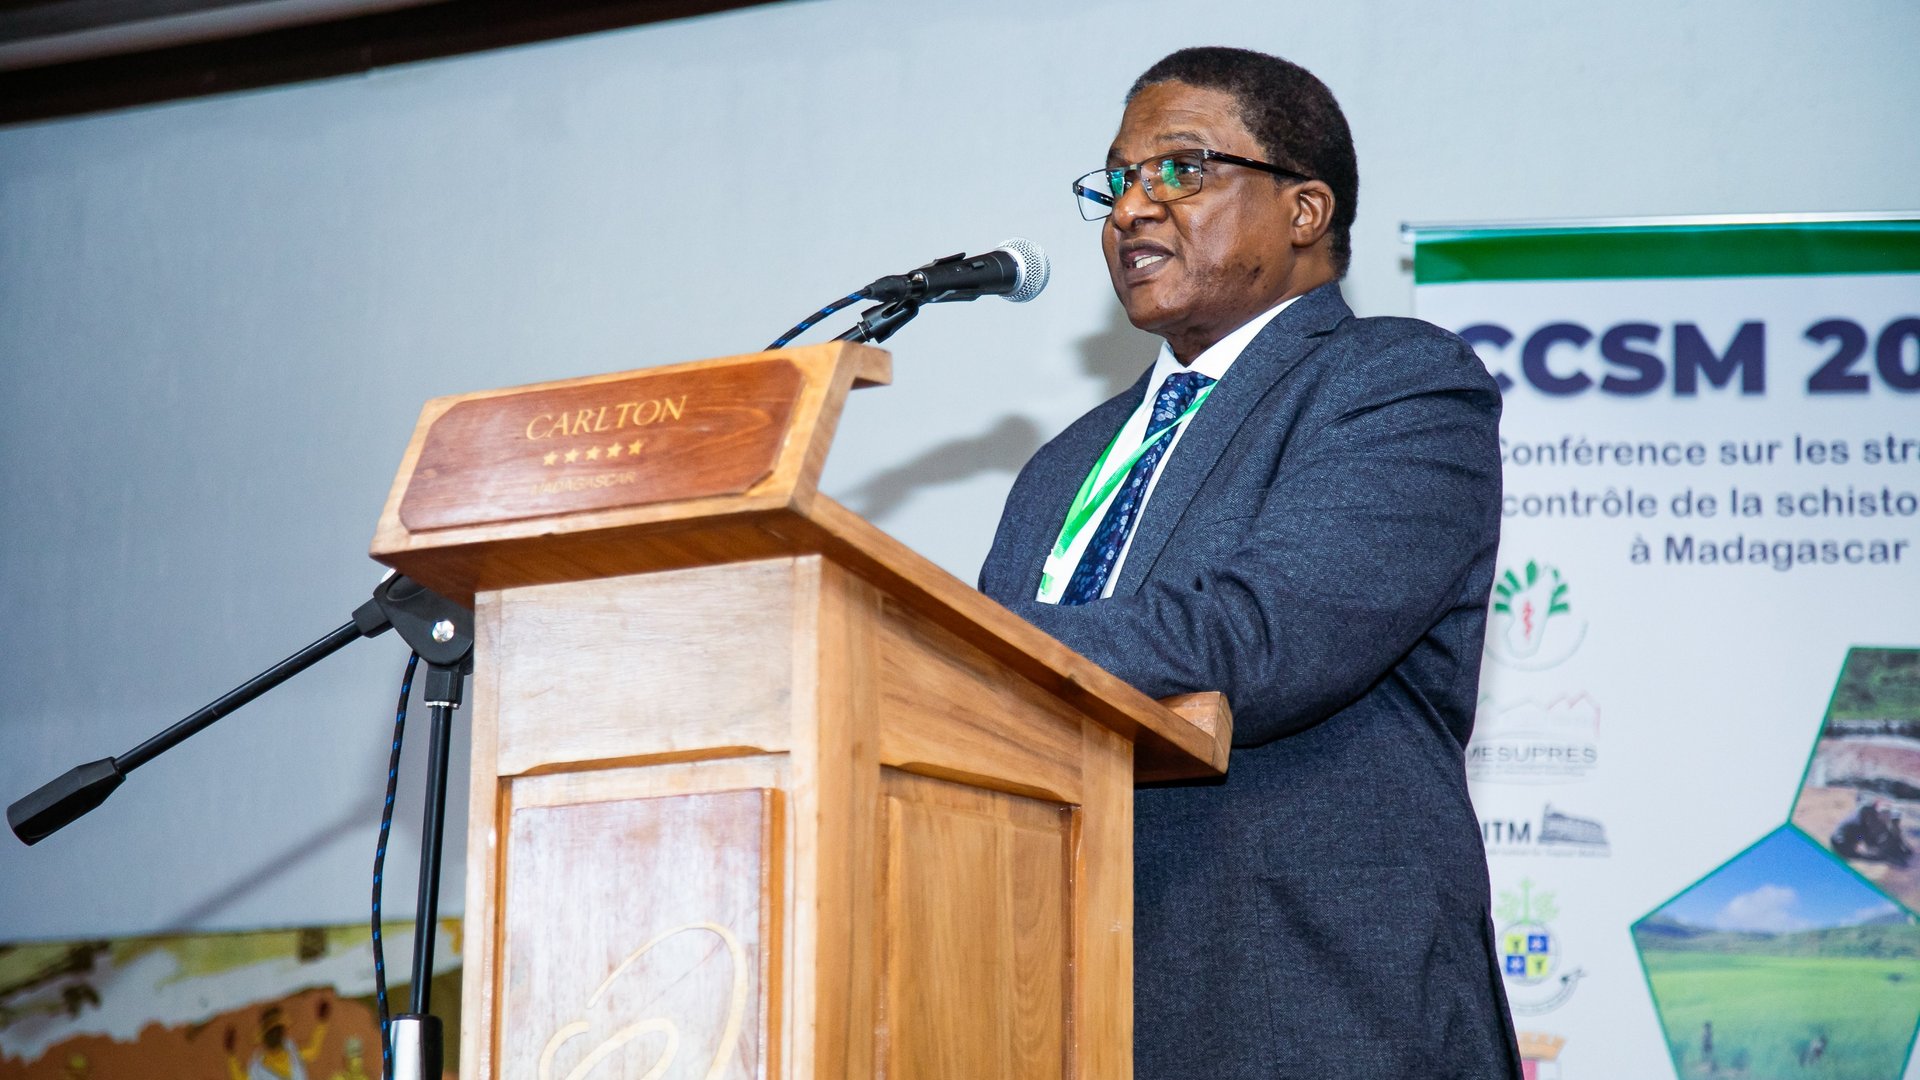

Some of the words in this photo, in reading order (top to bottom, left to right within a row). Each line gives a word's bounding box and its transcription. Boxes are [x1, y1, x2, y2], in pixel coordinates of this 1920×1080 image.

[1803, 317, 1920, 395] 20
[527, 396, 686, 440] CARLTON
[1720, 440, 1782, 466] sur
[1794, 432, 1849, 465] les
[1502, 486, 1657, 517] contrôle
[1671, 486, 1717, 517] de
[1731, 485, 1763, 517] la
[1776, 485, 1917, 517] schisto
[1630, 533, 1651, 564] à
[1665, 532, 1909, 572] Madagascar
